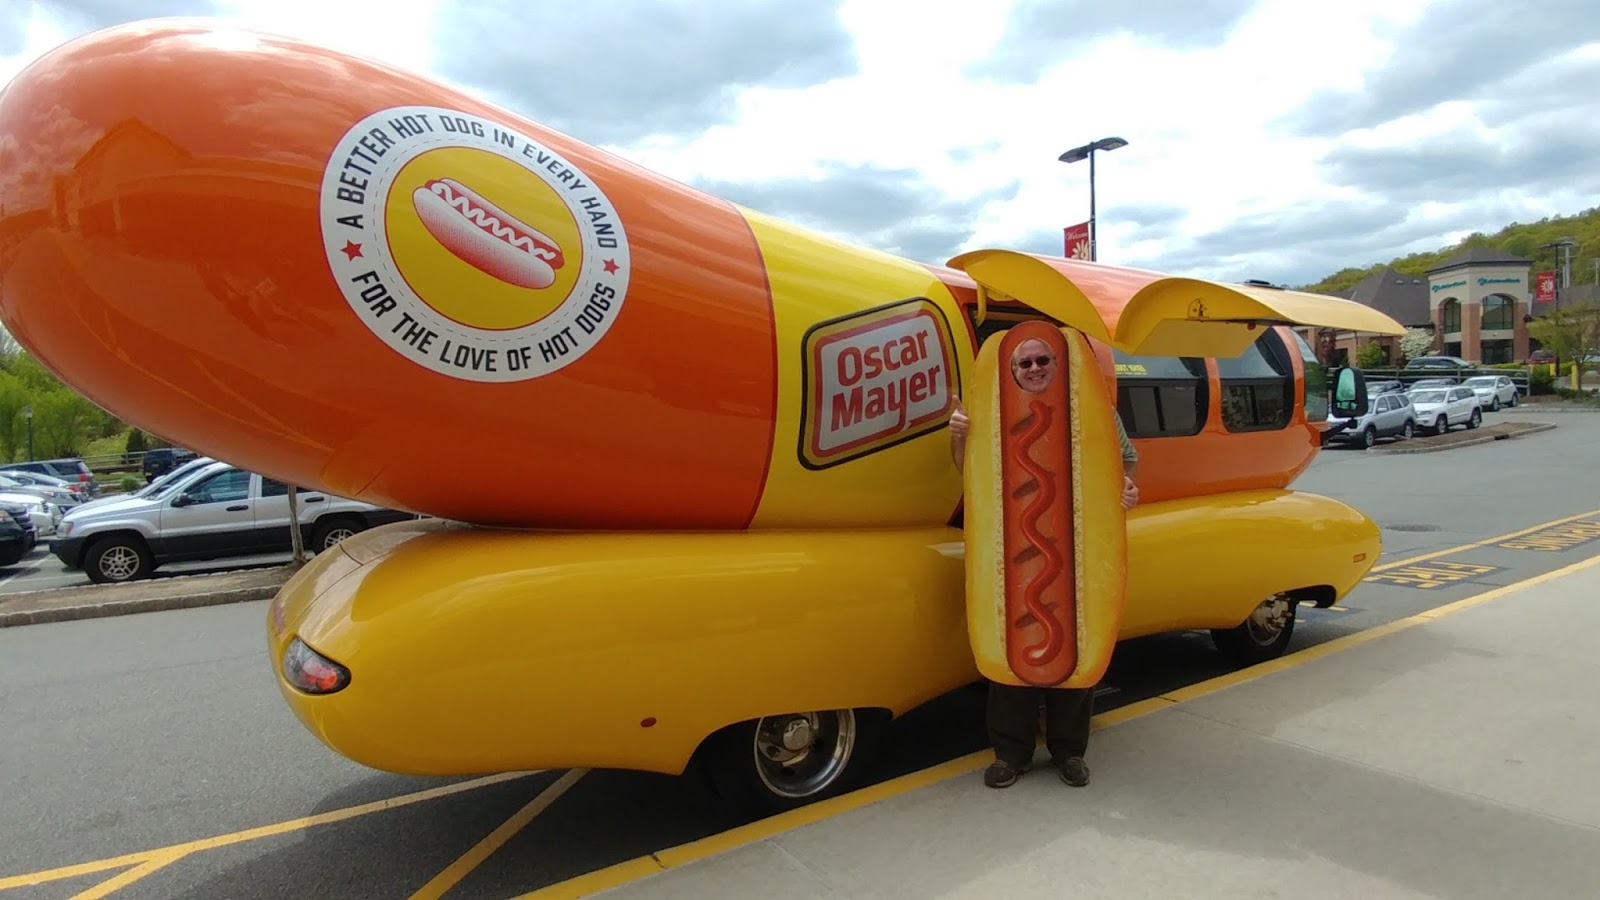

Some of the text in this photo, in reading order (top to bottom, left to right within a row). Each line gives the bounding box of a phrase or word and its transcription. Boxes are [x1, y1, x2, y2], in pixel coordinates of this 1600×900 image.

[336, 114, 618, 249] A BETTER HOT DOG IN EVERY HAND
[351, 270, 616, 372] FOR THE LOVE OF HOT DOGS
[837, 329, 929, 387] Oscar
[830, 364, 941, 432] Mayer
